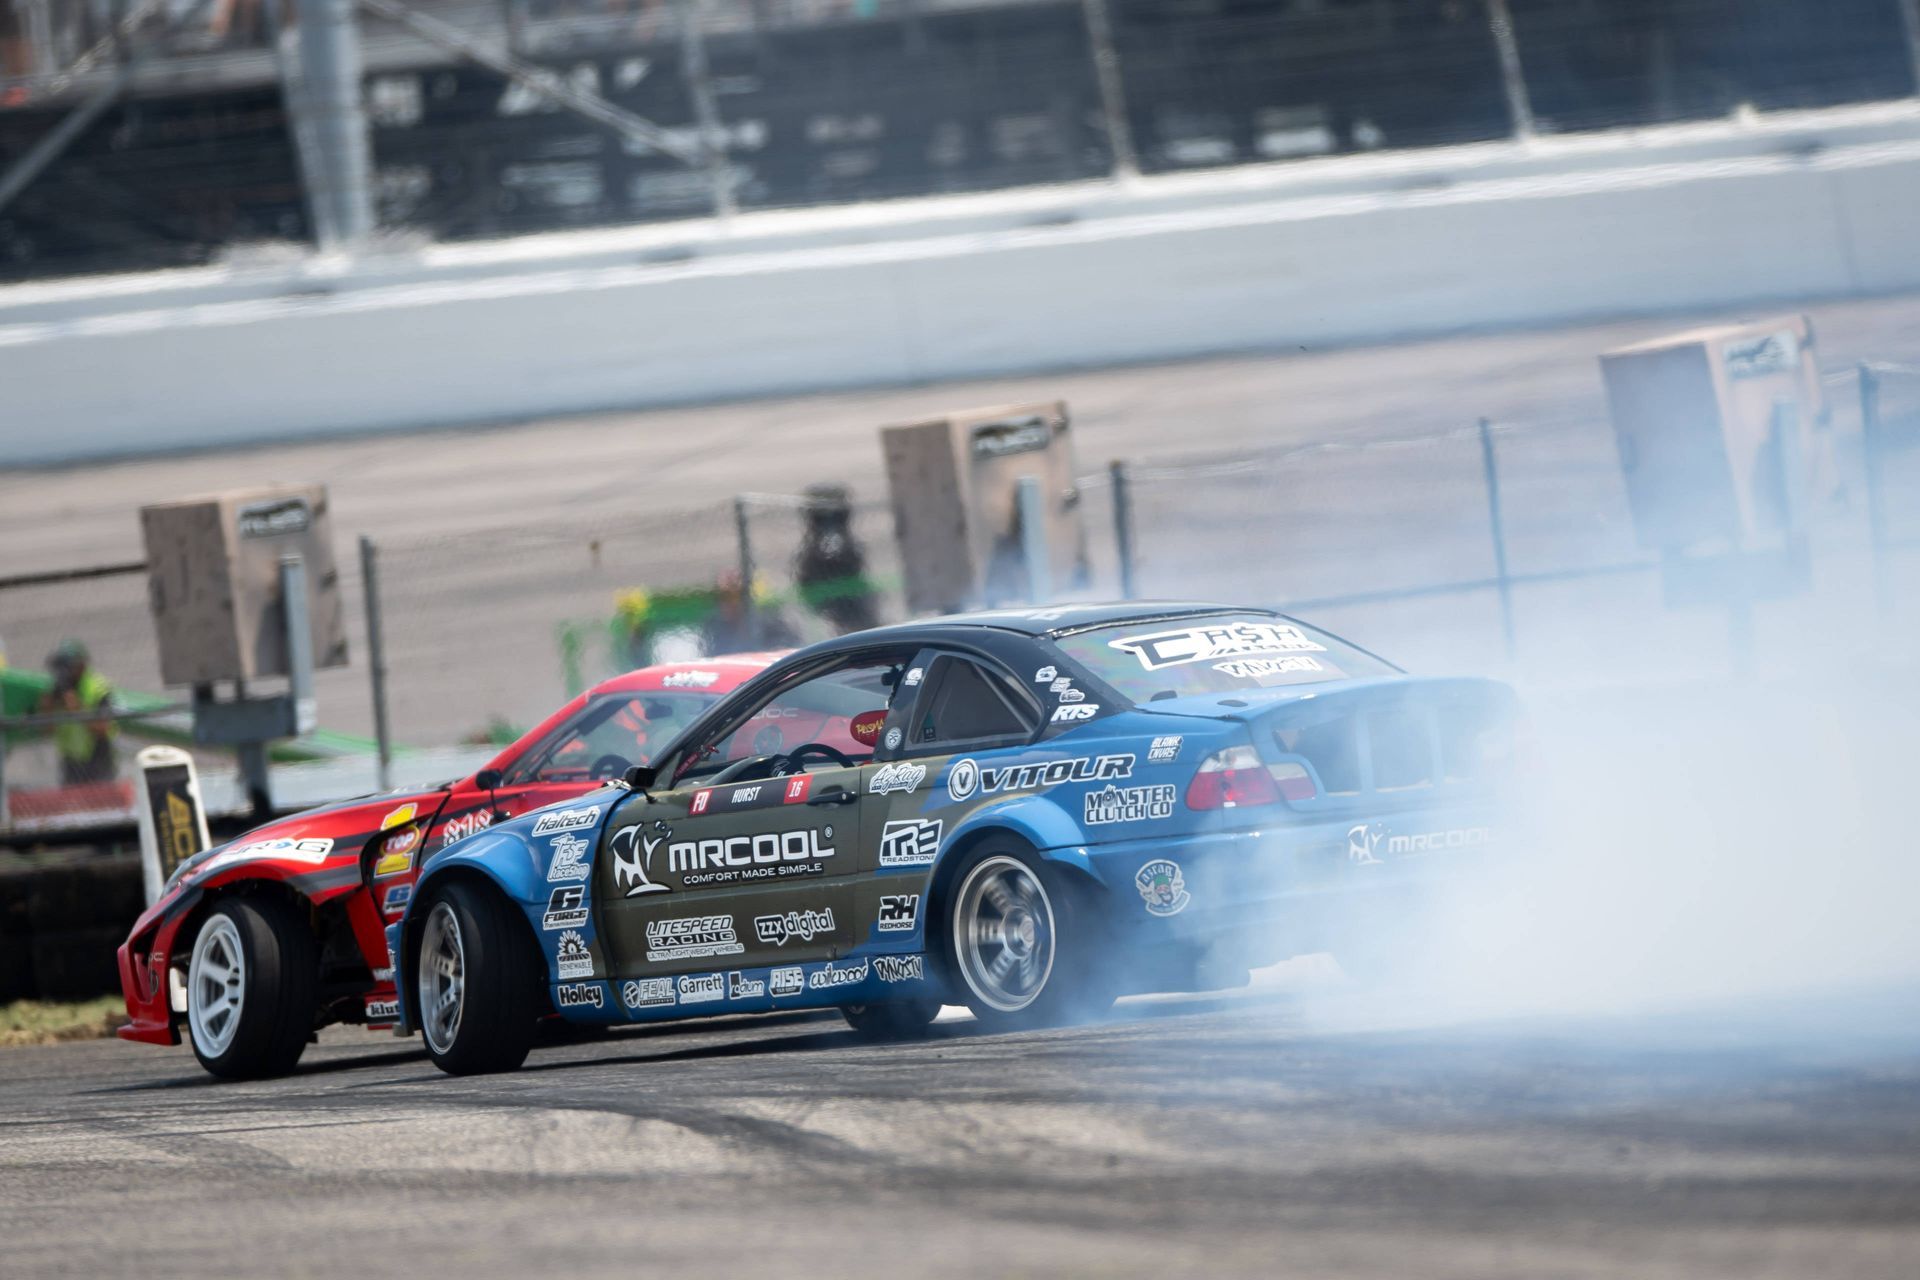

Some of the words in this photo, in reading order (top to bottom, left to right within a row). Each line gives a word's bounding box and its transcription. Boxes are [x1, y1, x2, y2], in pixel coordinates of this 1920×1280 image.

[982, 756, 1133, 790] VITOUR
[732, 786, 761, 803] HURST
[789, 781, 803, 798] 16
[1087, 785, 1174, 809] MONSTER
[693, 791, 710, 812] FD
[536, 811, 597, 832] Haltech
[1086, 804, 1144, 823] CLUTCH
[1150, 801, 1170, 816] CO
[882, 855, 935, 863] TREADSTONE
[684, 871, 739, 884] COMFORT
[742, 867, 775, 879] MADE
[778, 863, 823, 875] SIMPLE
[544, 909, 587, 922] FORCE
[881, 896, 918, 920] RH
[648, 917, 731, 936] LITESPEED
[880, 921, 913, 929] REDHORSE
[652, 931, 734, 946] RACING
[648, 951, 671, 959] ULTRA
[716, 944, 743, 953] WHEELS
[560, 961, 592, 970] RENEWABLE
[811, 957, 869, 988] wilwood
[640, 979, 675, 999] FEAL
[679, 975, 722, 994] Garrett
[560, 986, 601, 1007] Holley
